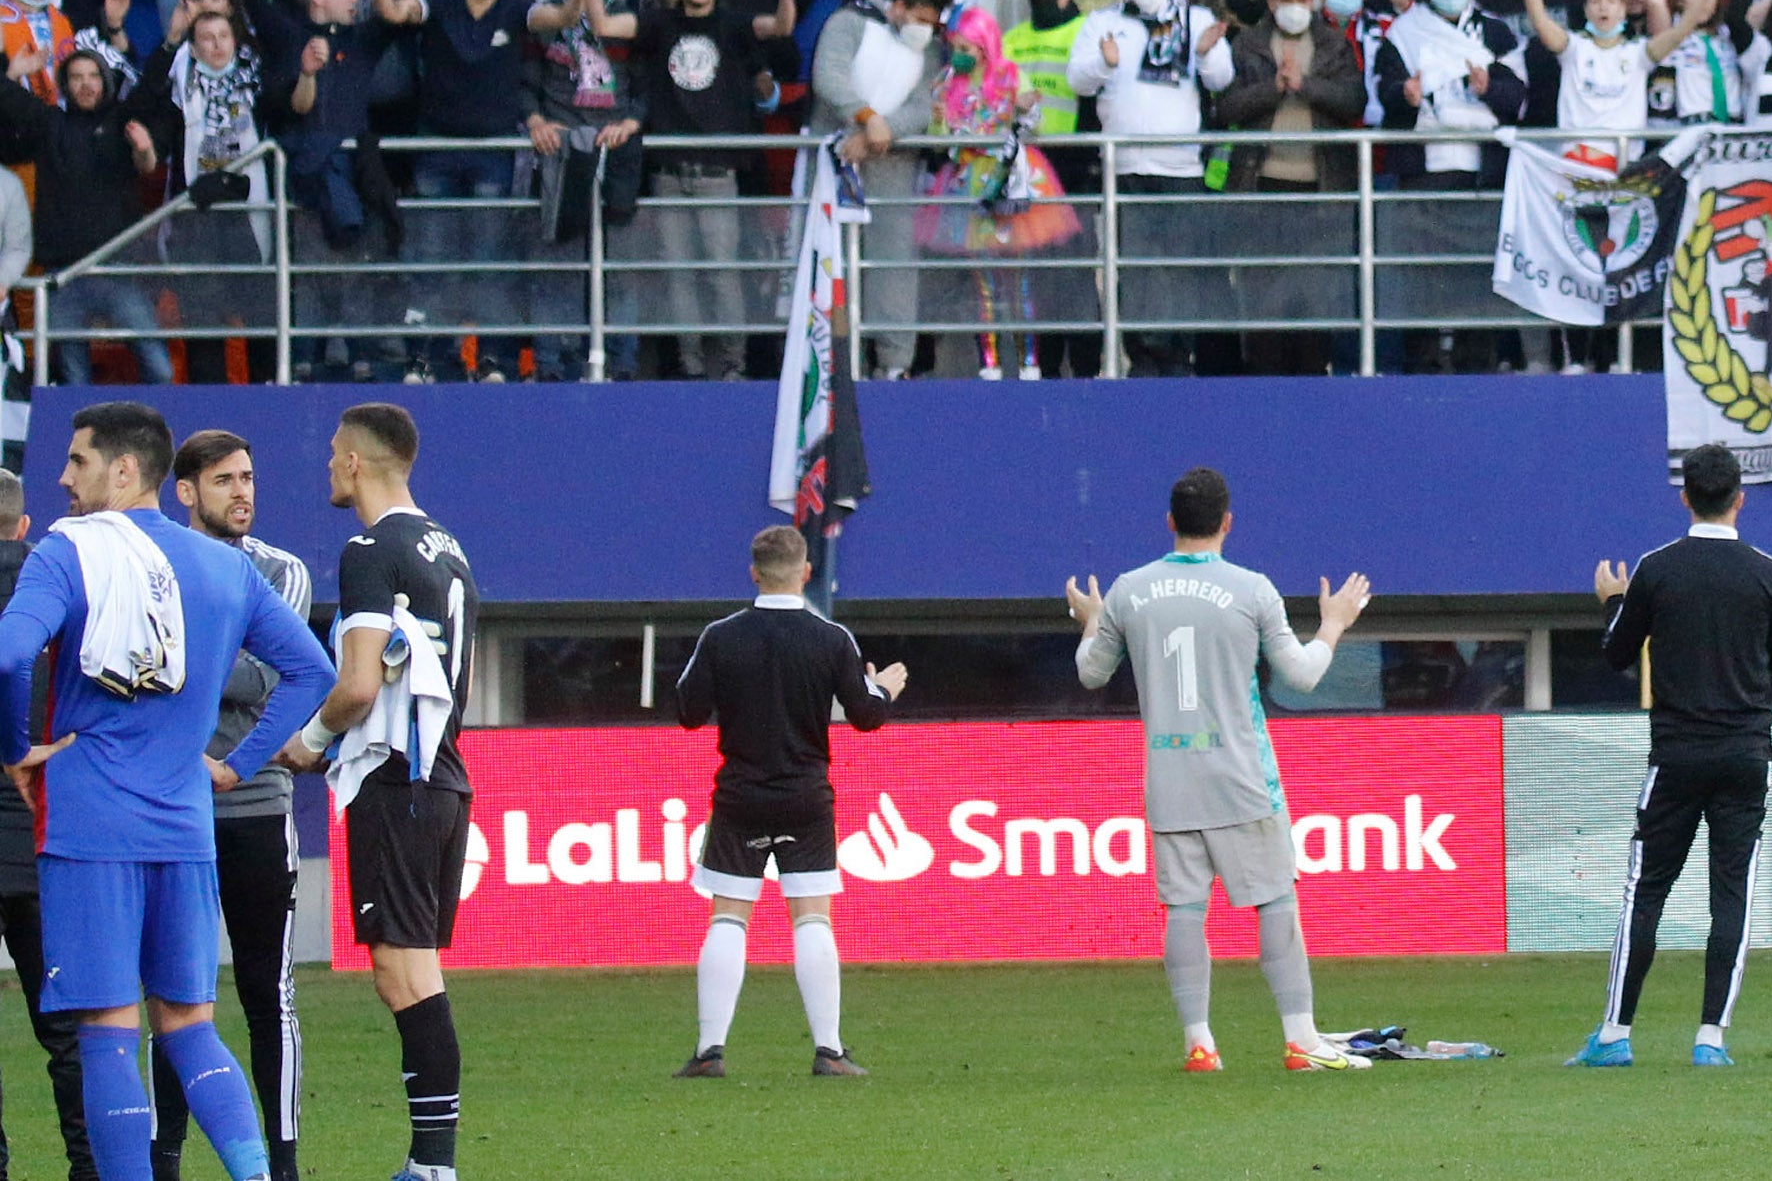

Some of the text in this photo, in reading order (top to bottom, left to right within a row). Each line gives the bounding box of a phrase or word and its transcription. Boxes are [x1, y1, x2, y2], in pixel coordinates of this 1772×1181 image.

[447, 577, 465, 689] 1
[1129, 578, 1234, 612] A. HERRERO
[1163, 626, 1198, 712] 1
[948, 793, 1457, 878] Smaank
